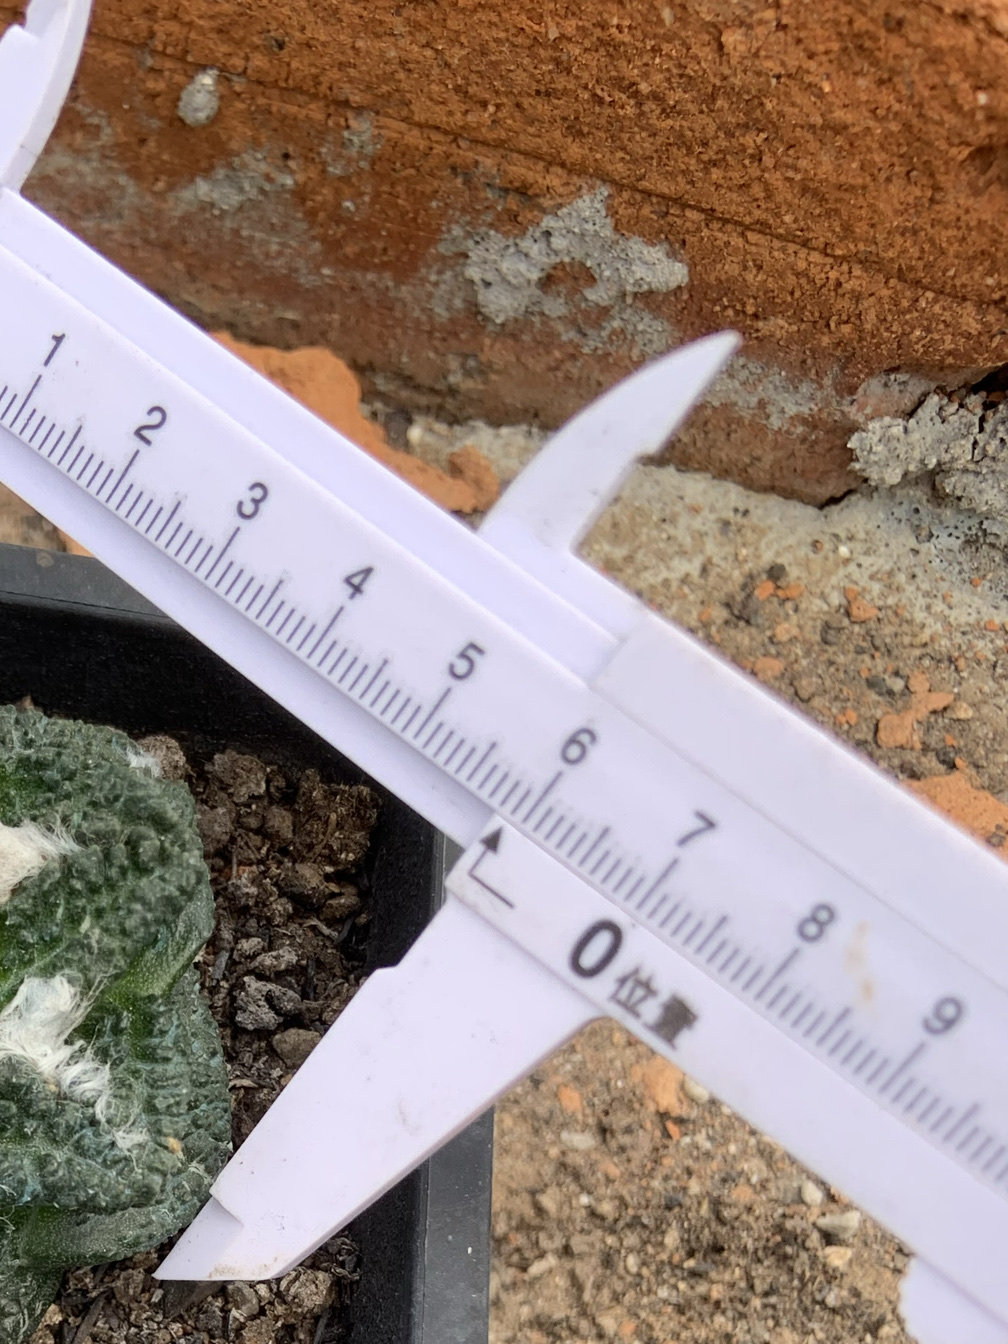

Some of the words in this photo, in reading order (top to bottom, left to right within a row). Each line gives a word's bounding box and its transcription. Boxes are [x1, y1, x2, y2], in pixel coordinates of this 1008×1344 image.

[44, 333, 66, 367] 1
[134, 406, 168, 446] 2
[237, 482, 269, 521] 3
[343, 566, 375, 601] 4
[449, 642, 485, 681] 5
[560, 727, 597, 766] 6
[677, 811, 717, 847] 7
[797, 904, 835, 943] 8
[923, 997, 964, 1036] 9
